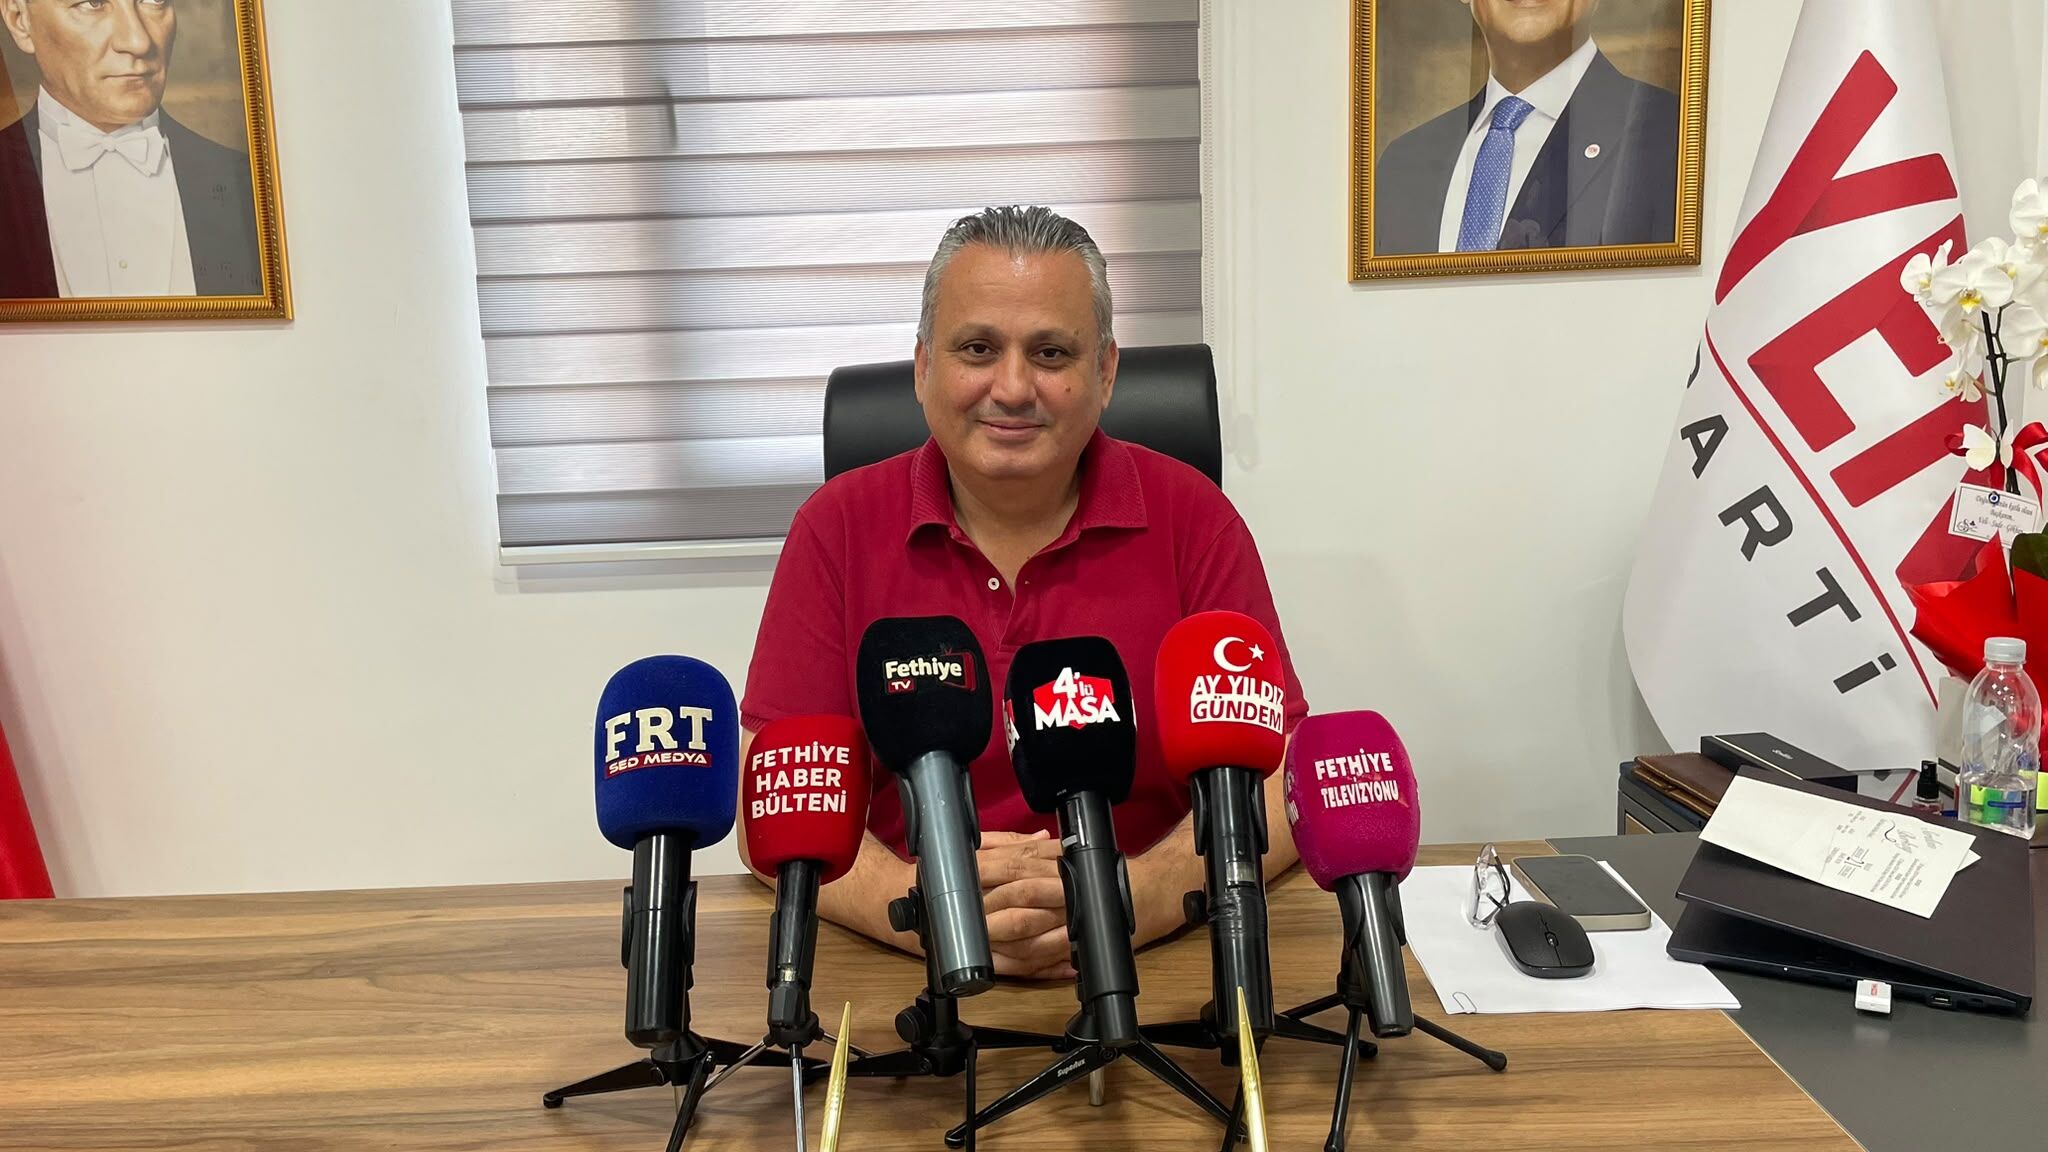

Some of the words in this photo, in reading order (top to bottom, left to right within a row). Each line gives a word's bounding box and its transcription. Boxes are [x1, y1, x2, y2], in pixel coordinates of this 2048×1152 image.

[1681, 338, 1897, 694] ARTİ
[885, 657, 962, 681] Fethiye
[891, 680, 911, 691] TV
[1191, 674, 1222, 695] AY
[1227, 674, 1284, 705] YILDIZ
[1033, 694, 1121, 731] MASA
[1192, 695, 1281, 732] GÜNDEM
[605, 706, 713, 763] FRT
[609, 757, 640, 775] SED
[643, 752, 708, 765] MEDYA
[751, 741, 850, 771] FETHİYE
[1314, 747, 1394, 781] FETHİYE
[756, 768, 842, 793] HABER
[1320, 776, 1399, 809] TELEVİZYONU
[751, 789, 848, 819] BÜLTENİ
